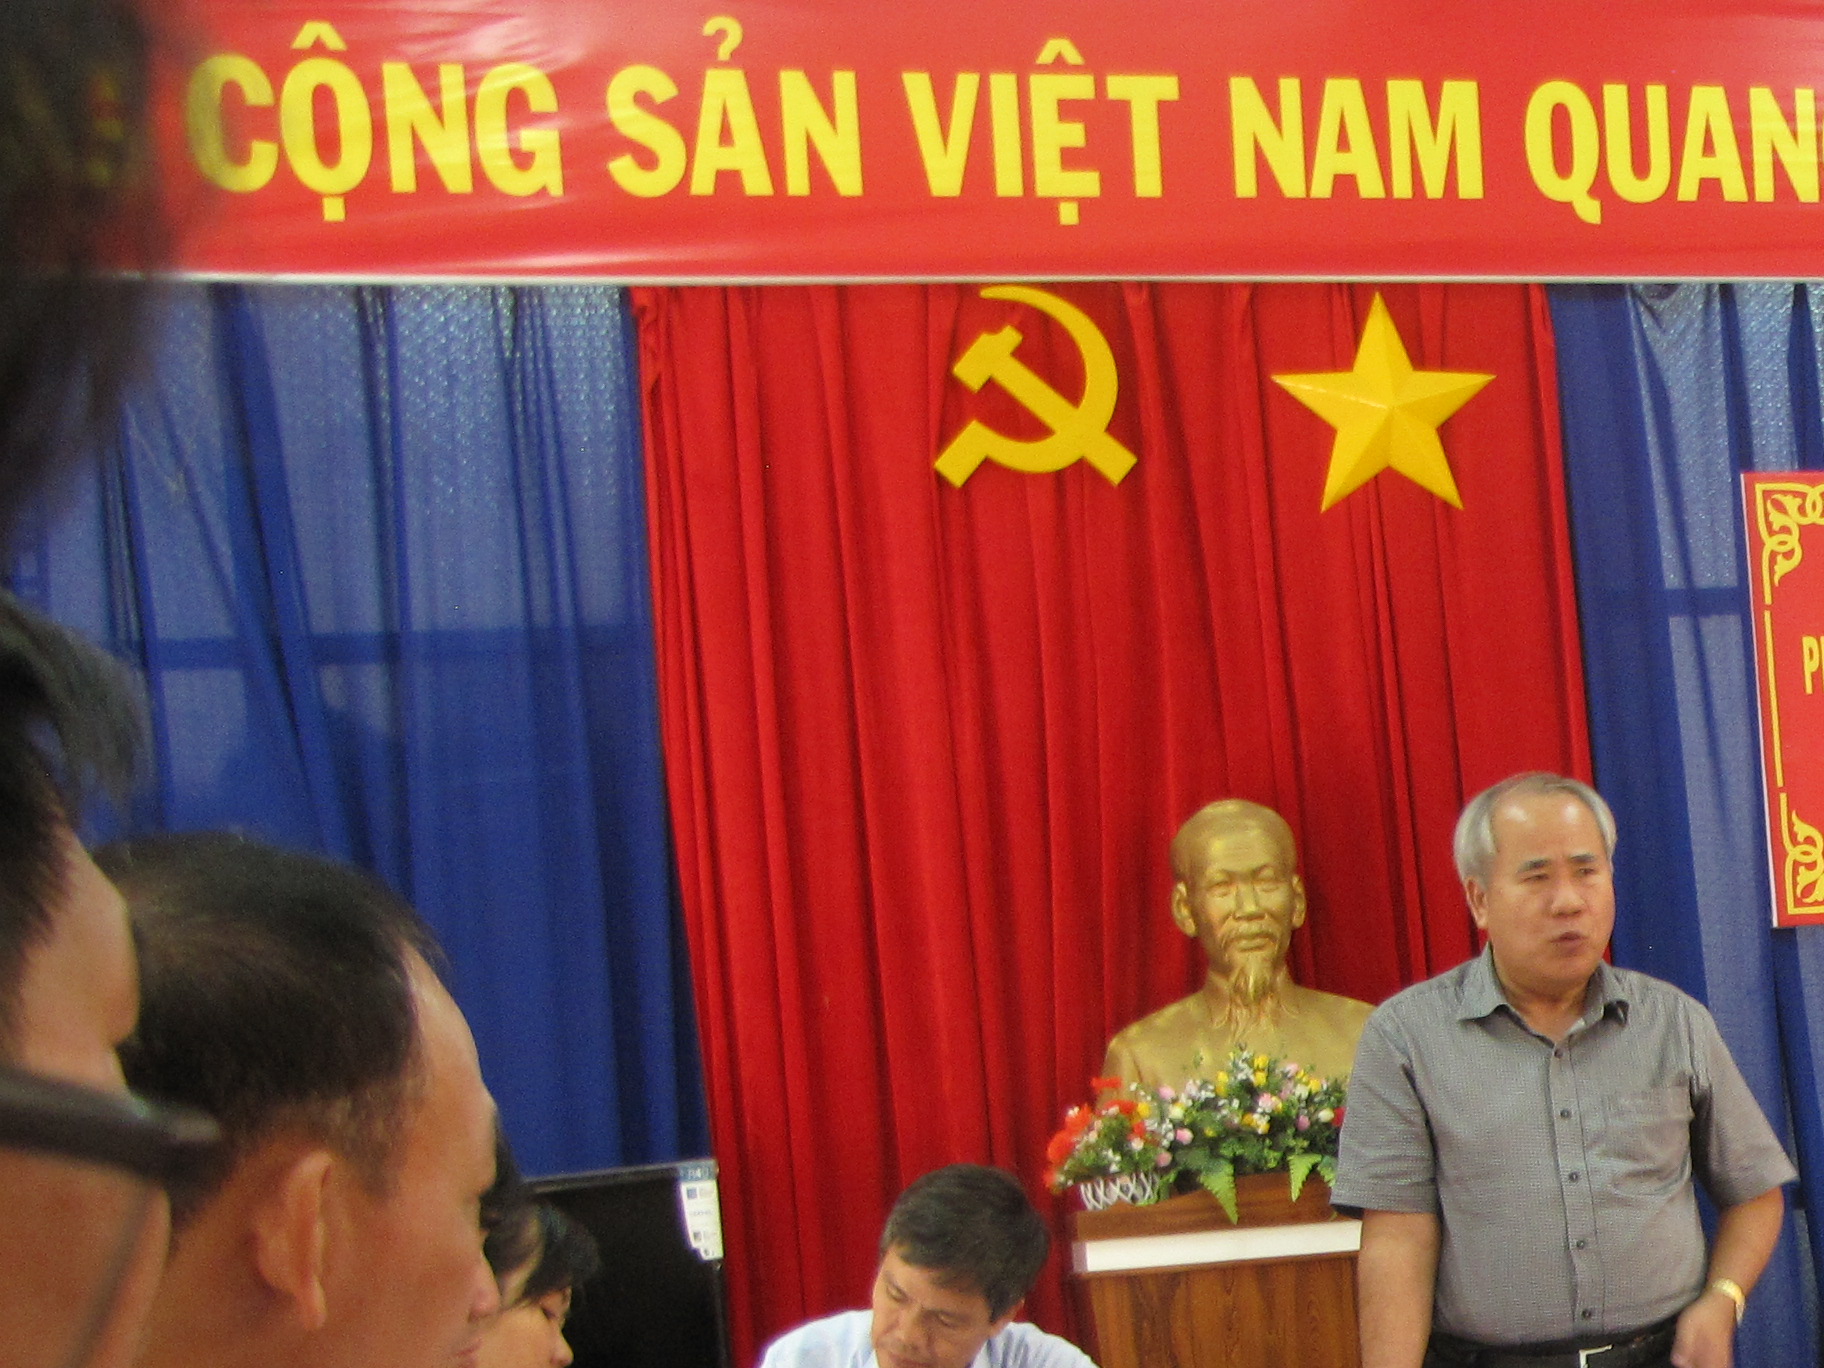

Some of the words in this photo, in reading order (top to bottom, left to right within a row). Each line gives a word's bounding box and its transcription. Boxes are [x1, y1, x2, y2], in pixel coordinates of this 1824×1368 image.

[185, 20, 563, 222] CỘNG
[607, 16, 864, 197] SẢN
[902, 38, 1179, 225] VIỆT
[1229, 77, 1485, 200] NAM
